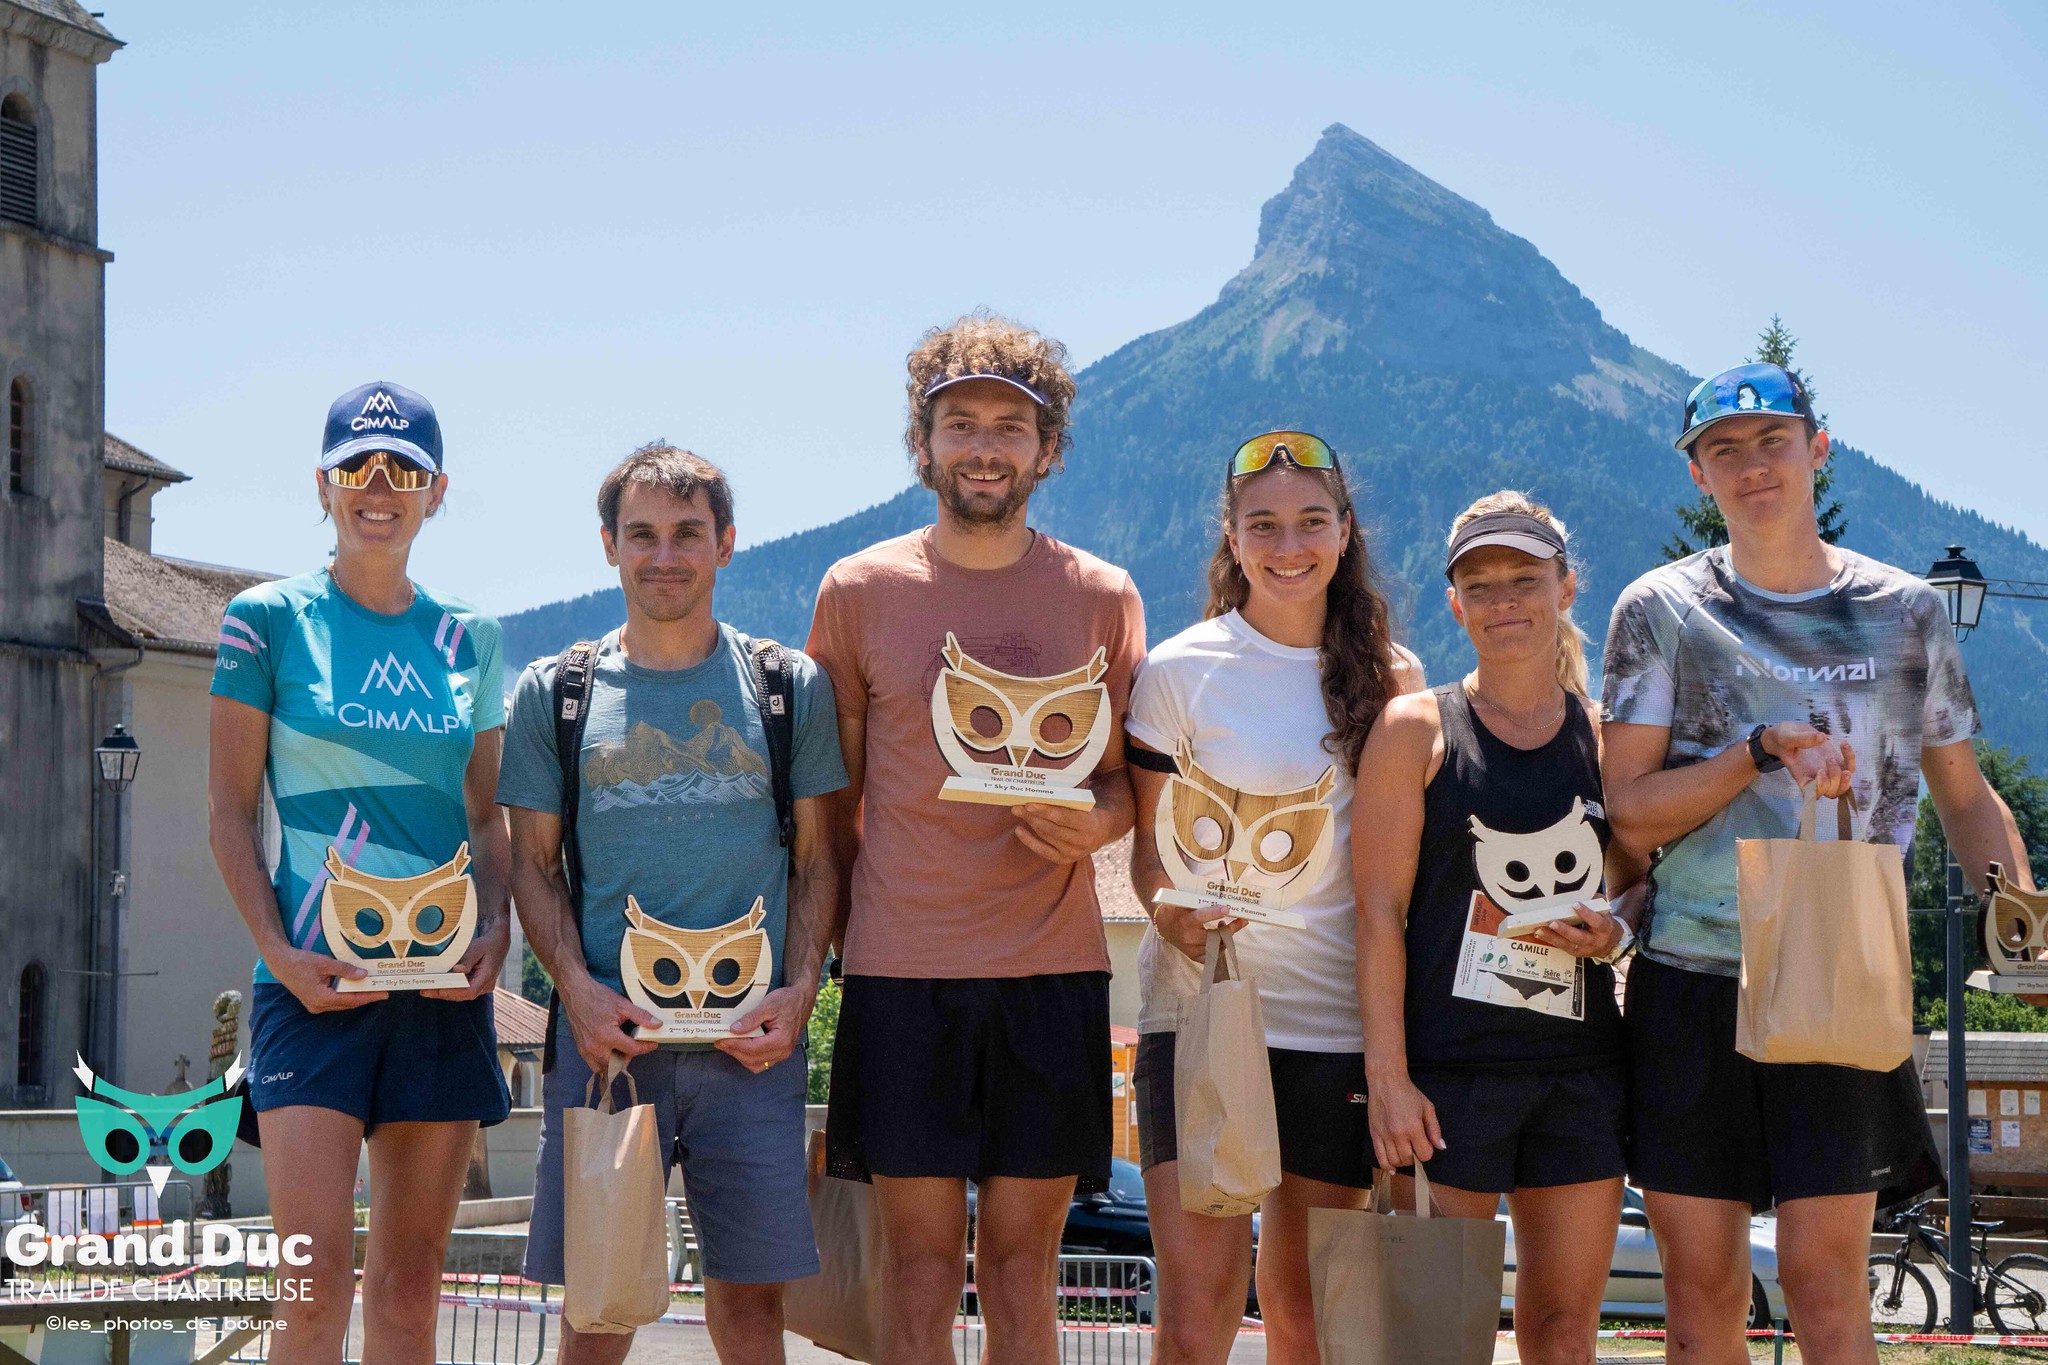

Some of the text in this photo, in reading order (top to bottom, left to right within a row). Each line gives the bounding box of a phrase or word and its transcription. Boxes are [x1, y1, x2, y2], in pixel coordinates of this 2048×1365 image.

[991, 767, 1046, 780] Grand Duc
[994, 783, 1009, 791] Sky
[1012, 778, 1046, 786] CHARTREUSE
[1207, 881, 1262, 899] Grand Duc
[1227, 894, 1261, 905] CHARTREUSE
[1511, 942, 1549, 956] CAMILLE
[377, 960, 426, 969] Grand Duc
[674, 1011, 721, 1019] Grand Duc
